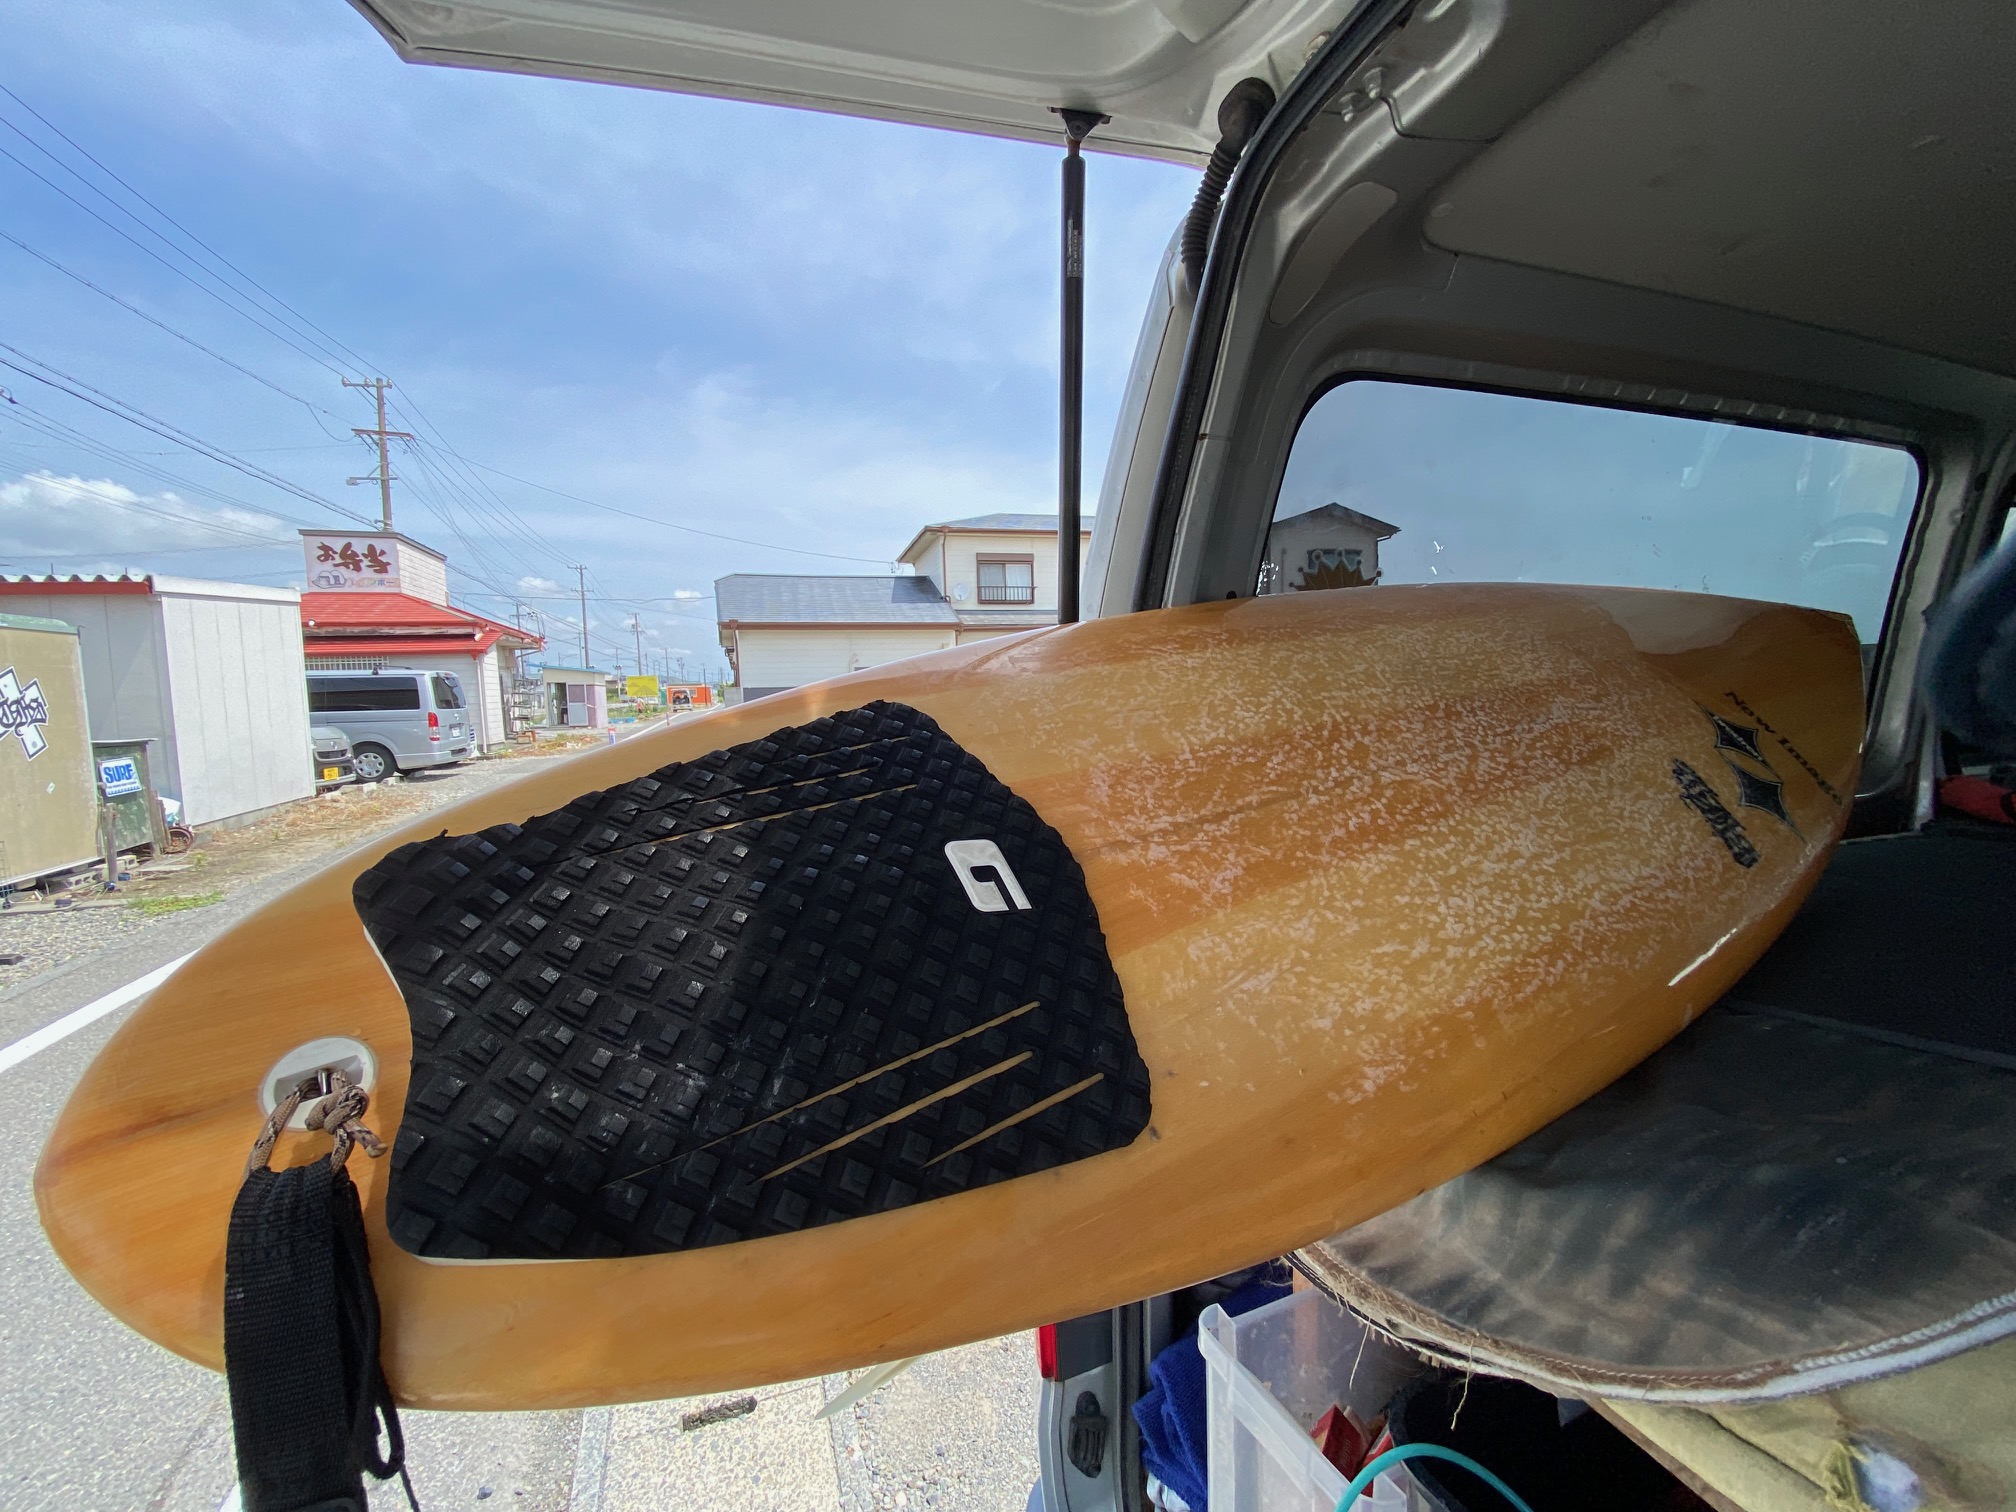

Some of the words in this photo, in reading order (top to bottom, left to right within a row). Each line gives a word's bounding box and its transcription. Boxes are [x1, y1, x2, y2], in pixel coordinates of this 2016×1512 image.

[316, 541, 392, 574] お弁当
[103, 763, 134, 784] SURF
